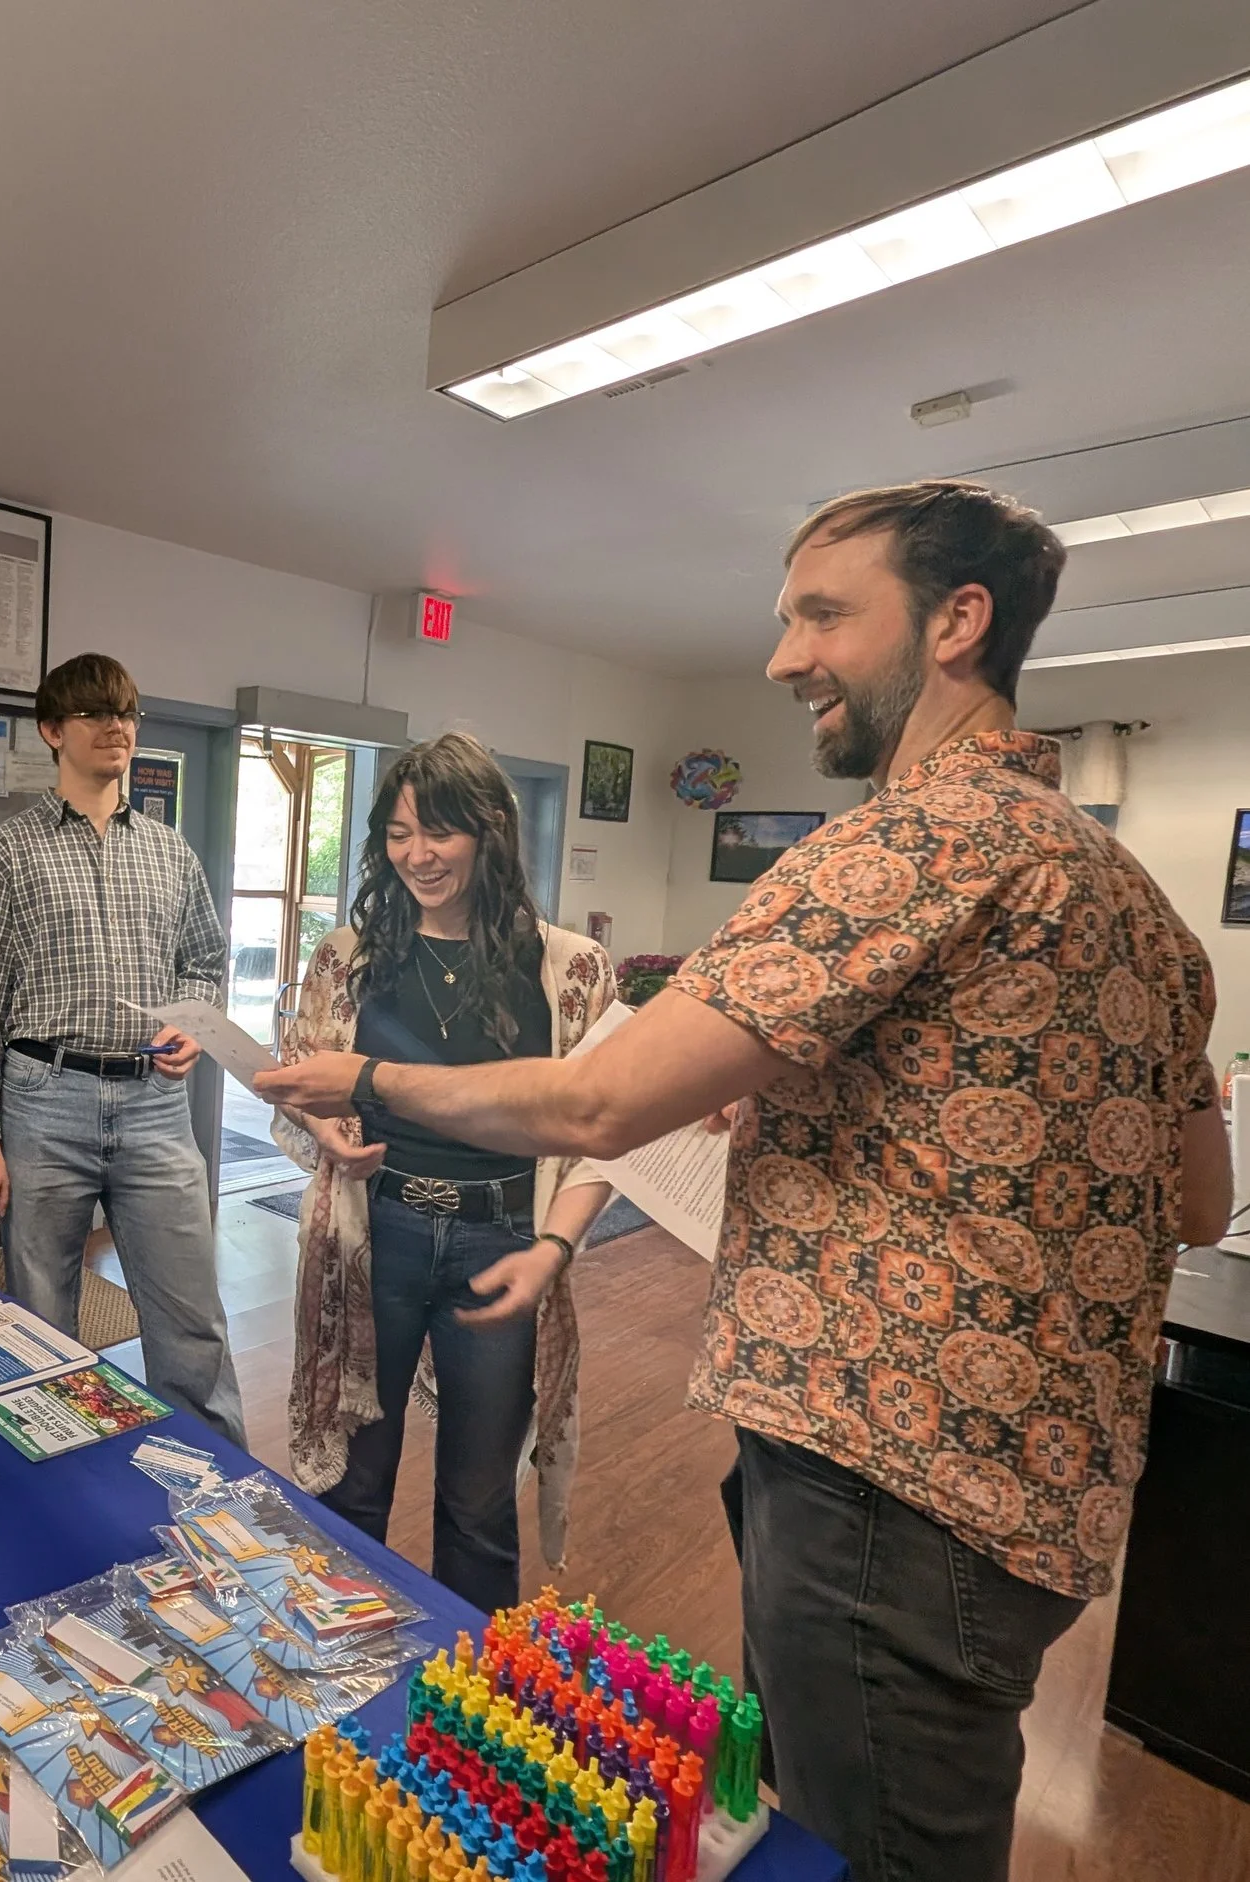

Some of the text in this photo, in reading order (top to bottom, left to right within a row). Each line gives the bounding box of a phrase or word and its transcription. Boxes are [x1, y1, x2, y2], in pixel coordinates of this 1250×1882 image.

[423, 597, 452, 640] EXIT
[134, 776, 175, 787] YOUR VISIT?
[138, 767, 172, 778] HOW WAS
[21, 1395, 49, 1416] VEGGIES
[11, 1398, 67, 1441] GET DOUBLE THE
[51, 1420, 77, 1438] FRUITS
[67, 1747, 88, 1773] KID
[85, 1755, 120, 1789] UAD
